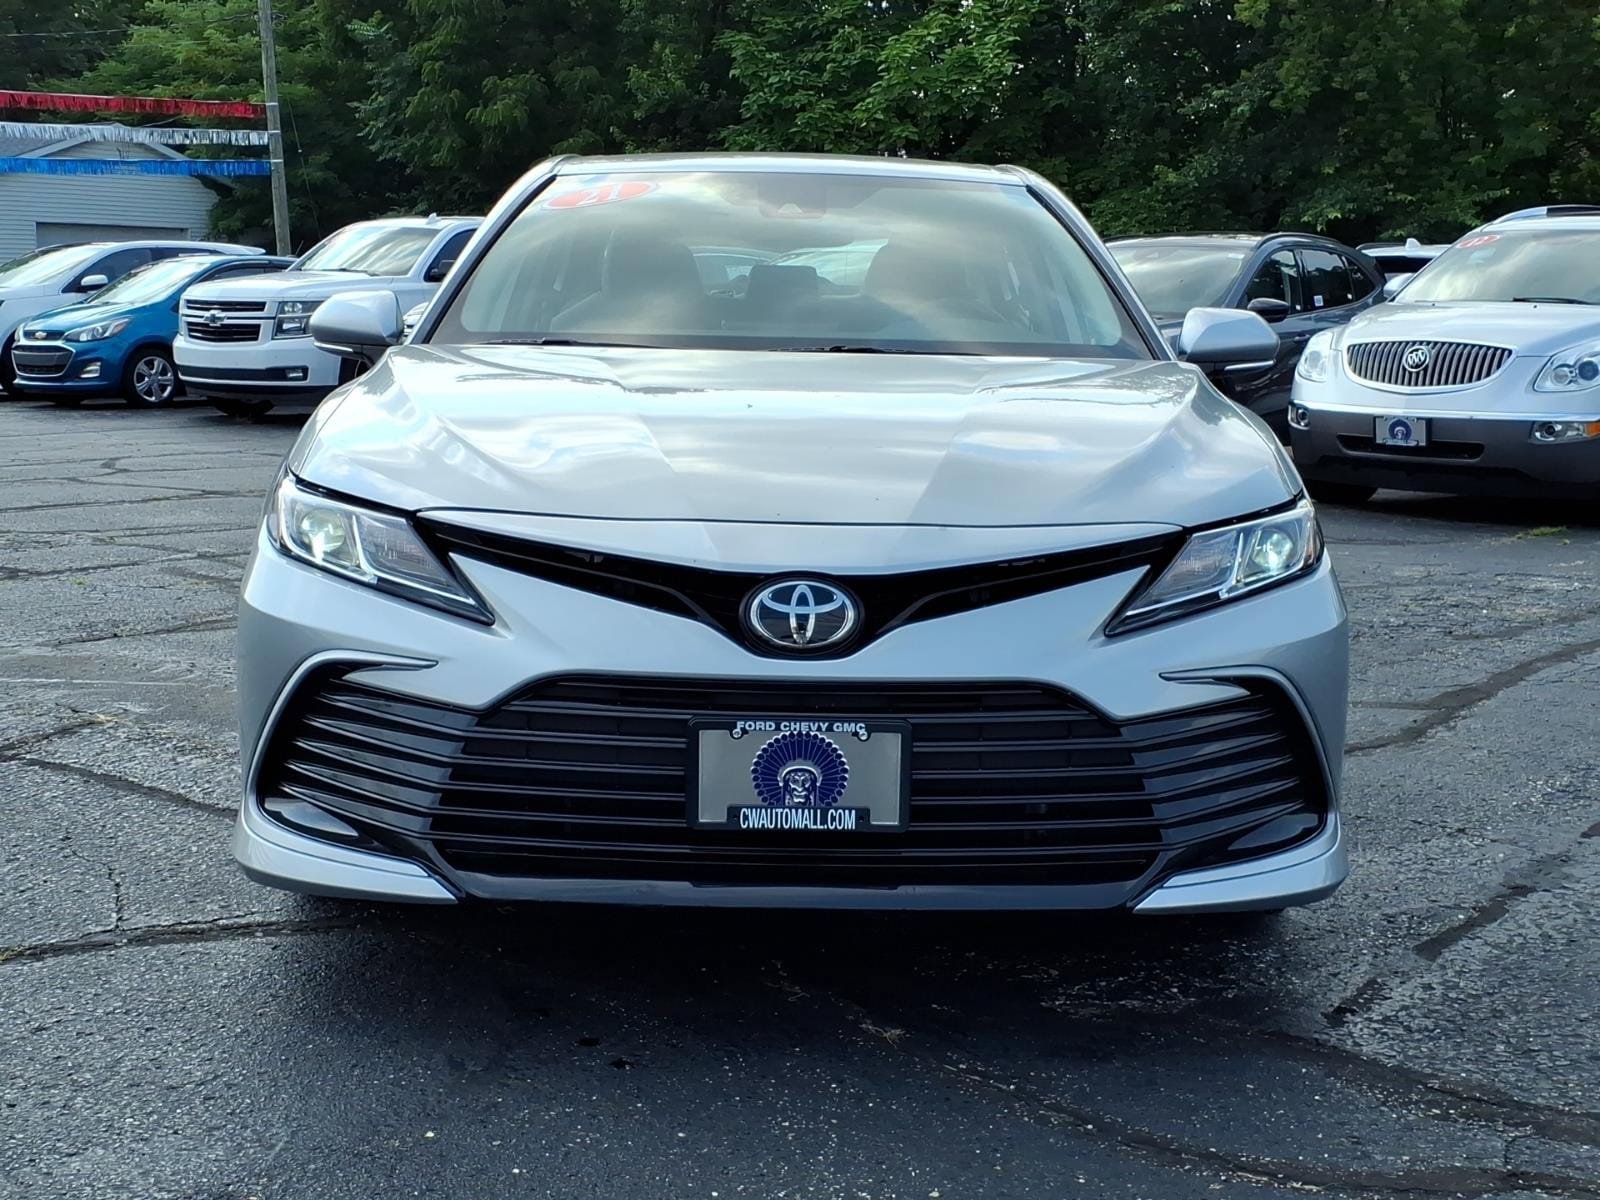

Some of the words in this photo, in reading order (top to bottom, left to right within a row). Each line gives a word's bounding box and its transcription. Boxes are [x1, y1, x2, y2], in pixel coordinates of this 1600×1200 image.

[736, 721, 776, 731] FORD
[780, 721, 829, 732] CHEVY
[832, 722, 866, 732] GMC
[740, 807, 856, 830] CWAUTOMALL.COM
